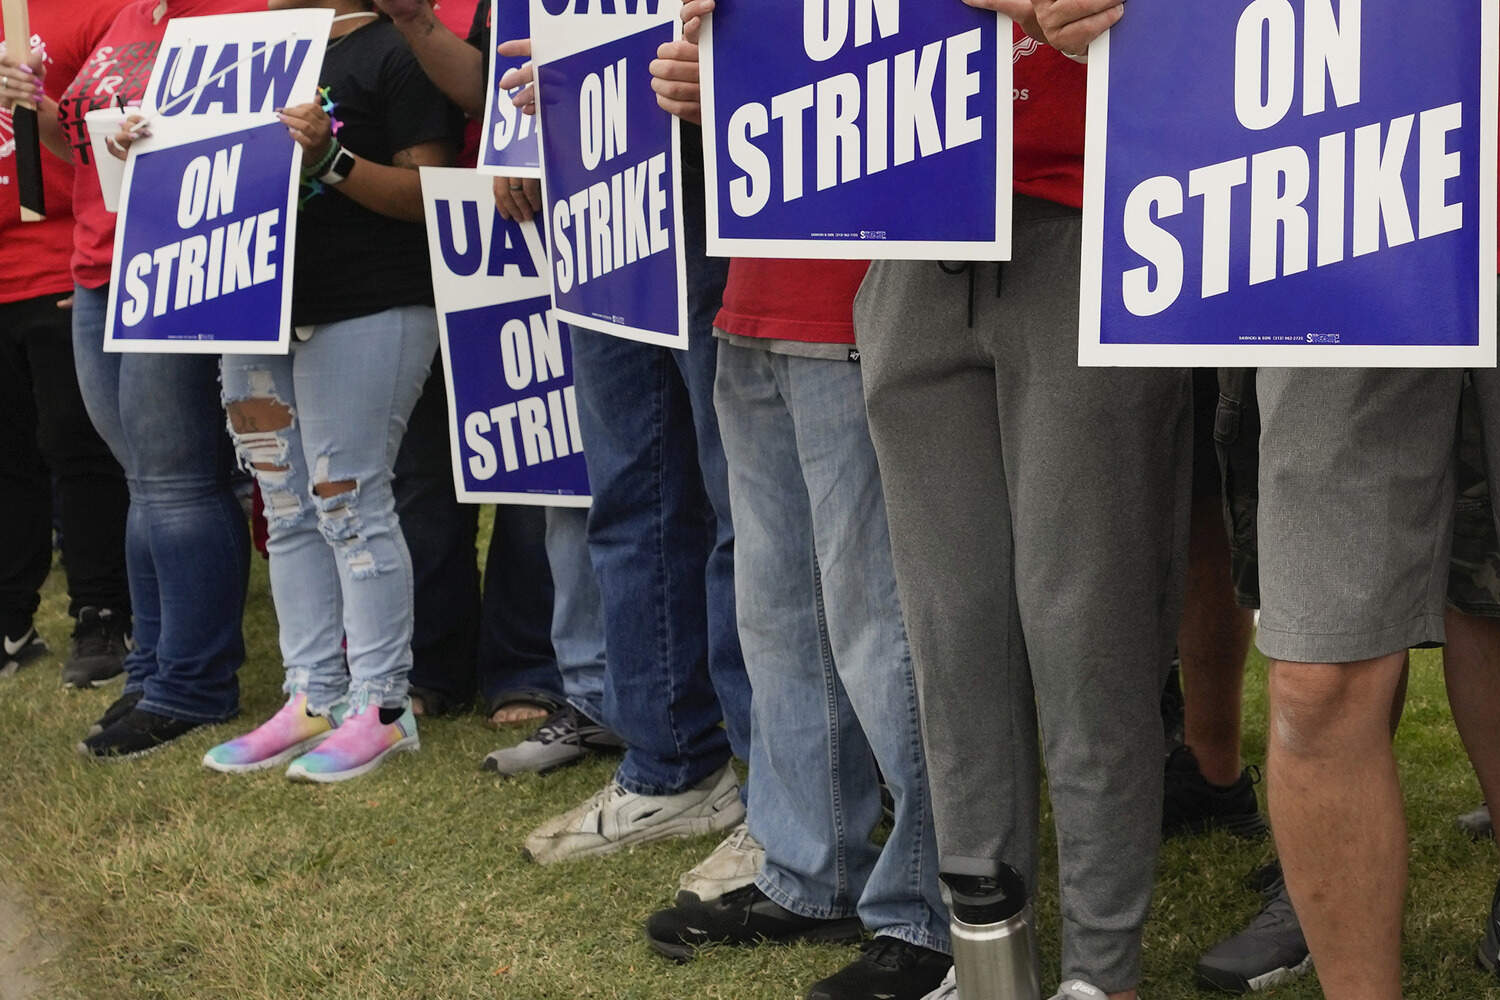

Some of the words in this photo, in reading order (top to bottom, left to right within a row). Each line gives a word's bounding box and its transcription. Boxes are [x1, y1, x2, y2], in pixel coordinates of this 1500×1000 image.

[155, 38, 313, 117] UAW
[578, 57, 628, 172] ON
[727, 27, 983, 218] STRIKE
[177, 143, 243, 230] ON
[434, 198, 548, 278] UA
[552, 151, 670, 294] STRIKE
[1122, 101, 1464, 317] STRIKE
[120, 208, 281, 327] STRIKE
[499, 310, 565, 390] ON
